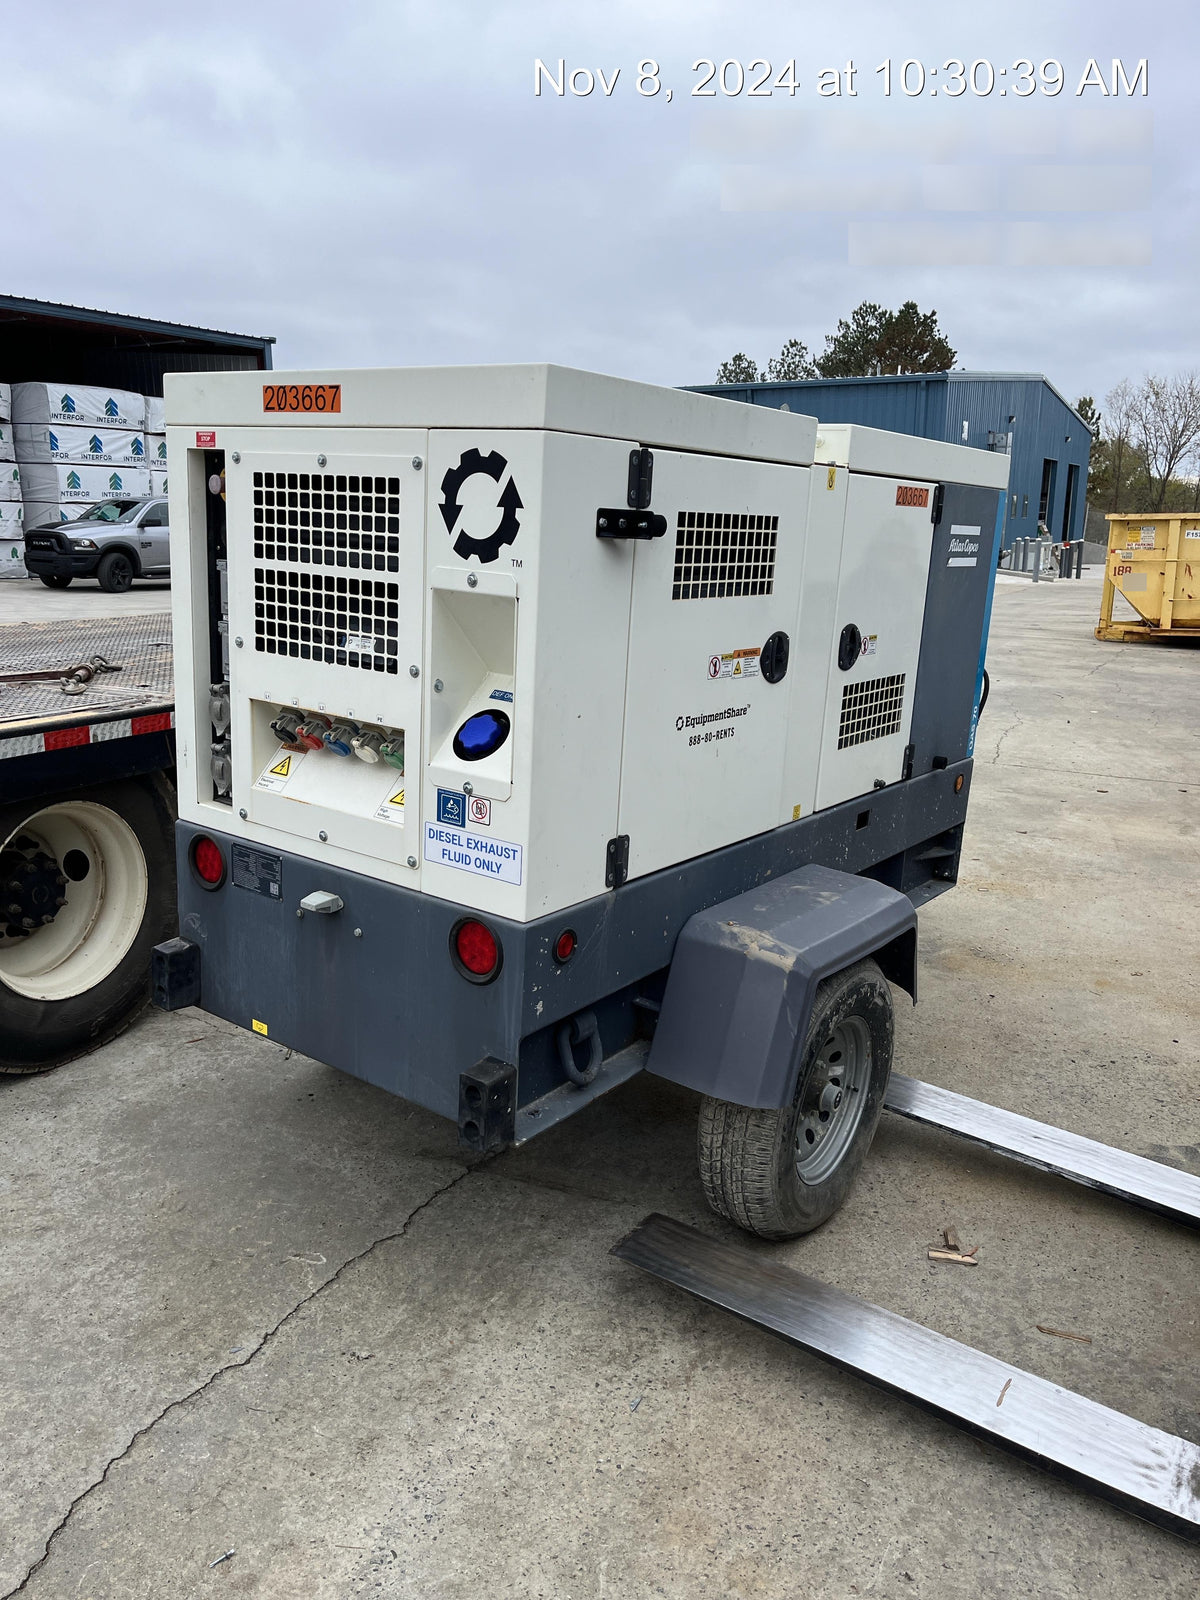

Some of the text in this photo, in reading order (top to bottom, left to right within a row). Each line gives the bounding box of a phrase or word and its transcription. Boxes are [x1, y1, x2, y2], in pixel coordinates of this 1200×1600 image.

[264, 385, 340, 411] 203667
[51, 413, 85, 421] INTERFOR
[96, 417, 128, 425] INTERFOR
[896, 486, 929, 506] 203667
[511, 559, 523, 568] TM
[689, 727, 735, 747] 888-80-RENTS
[428, 827, 518, 860] DIESEL EXHAUST
[442, 848, 502, 874] FLUID ONLY
